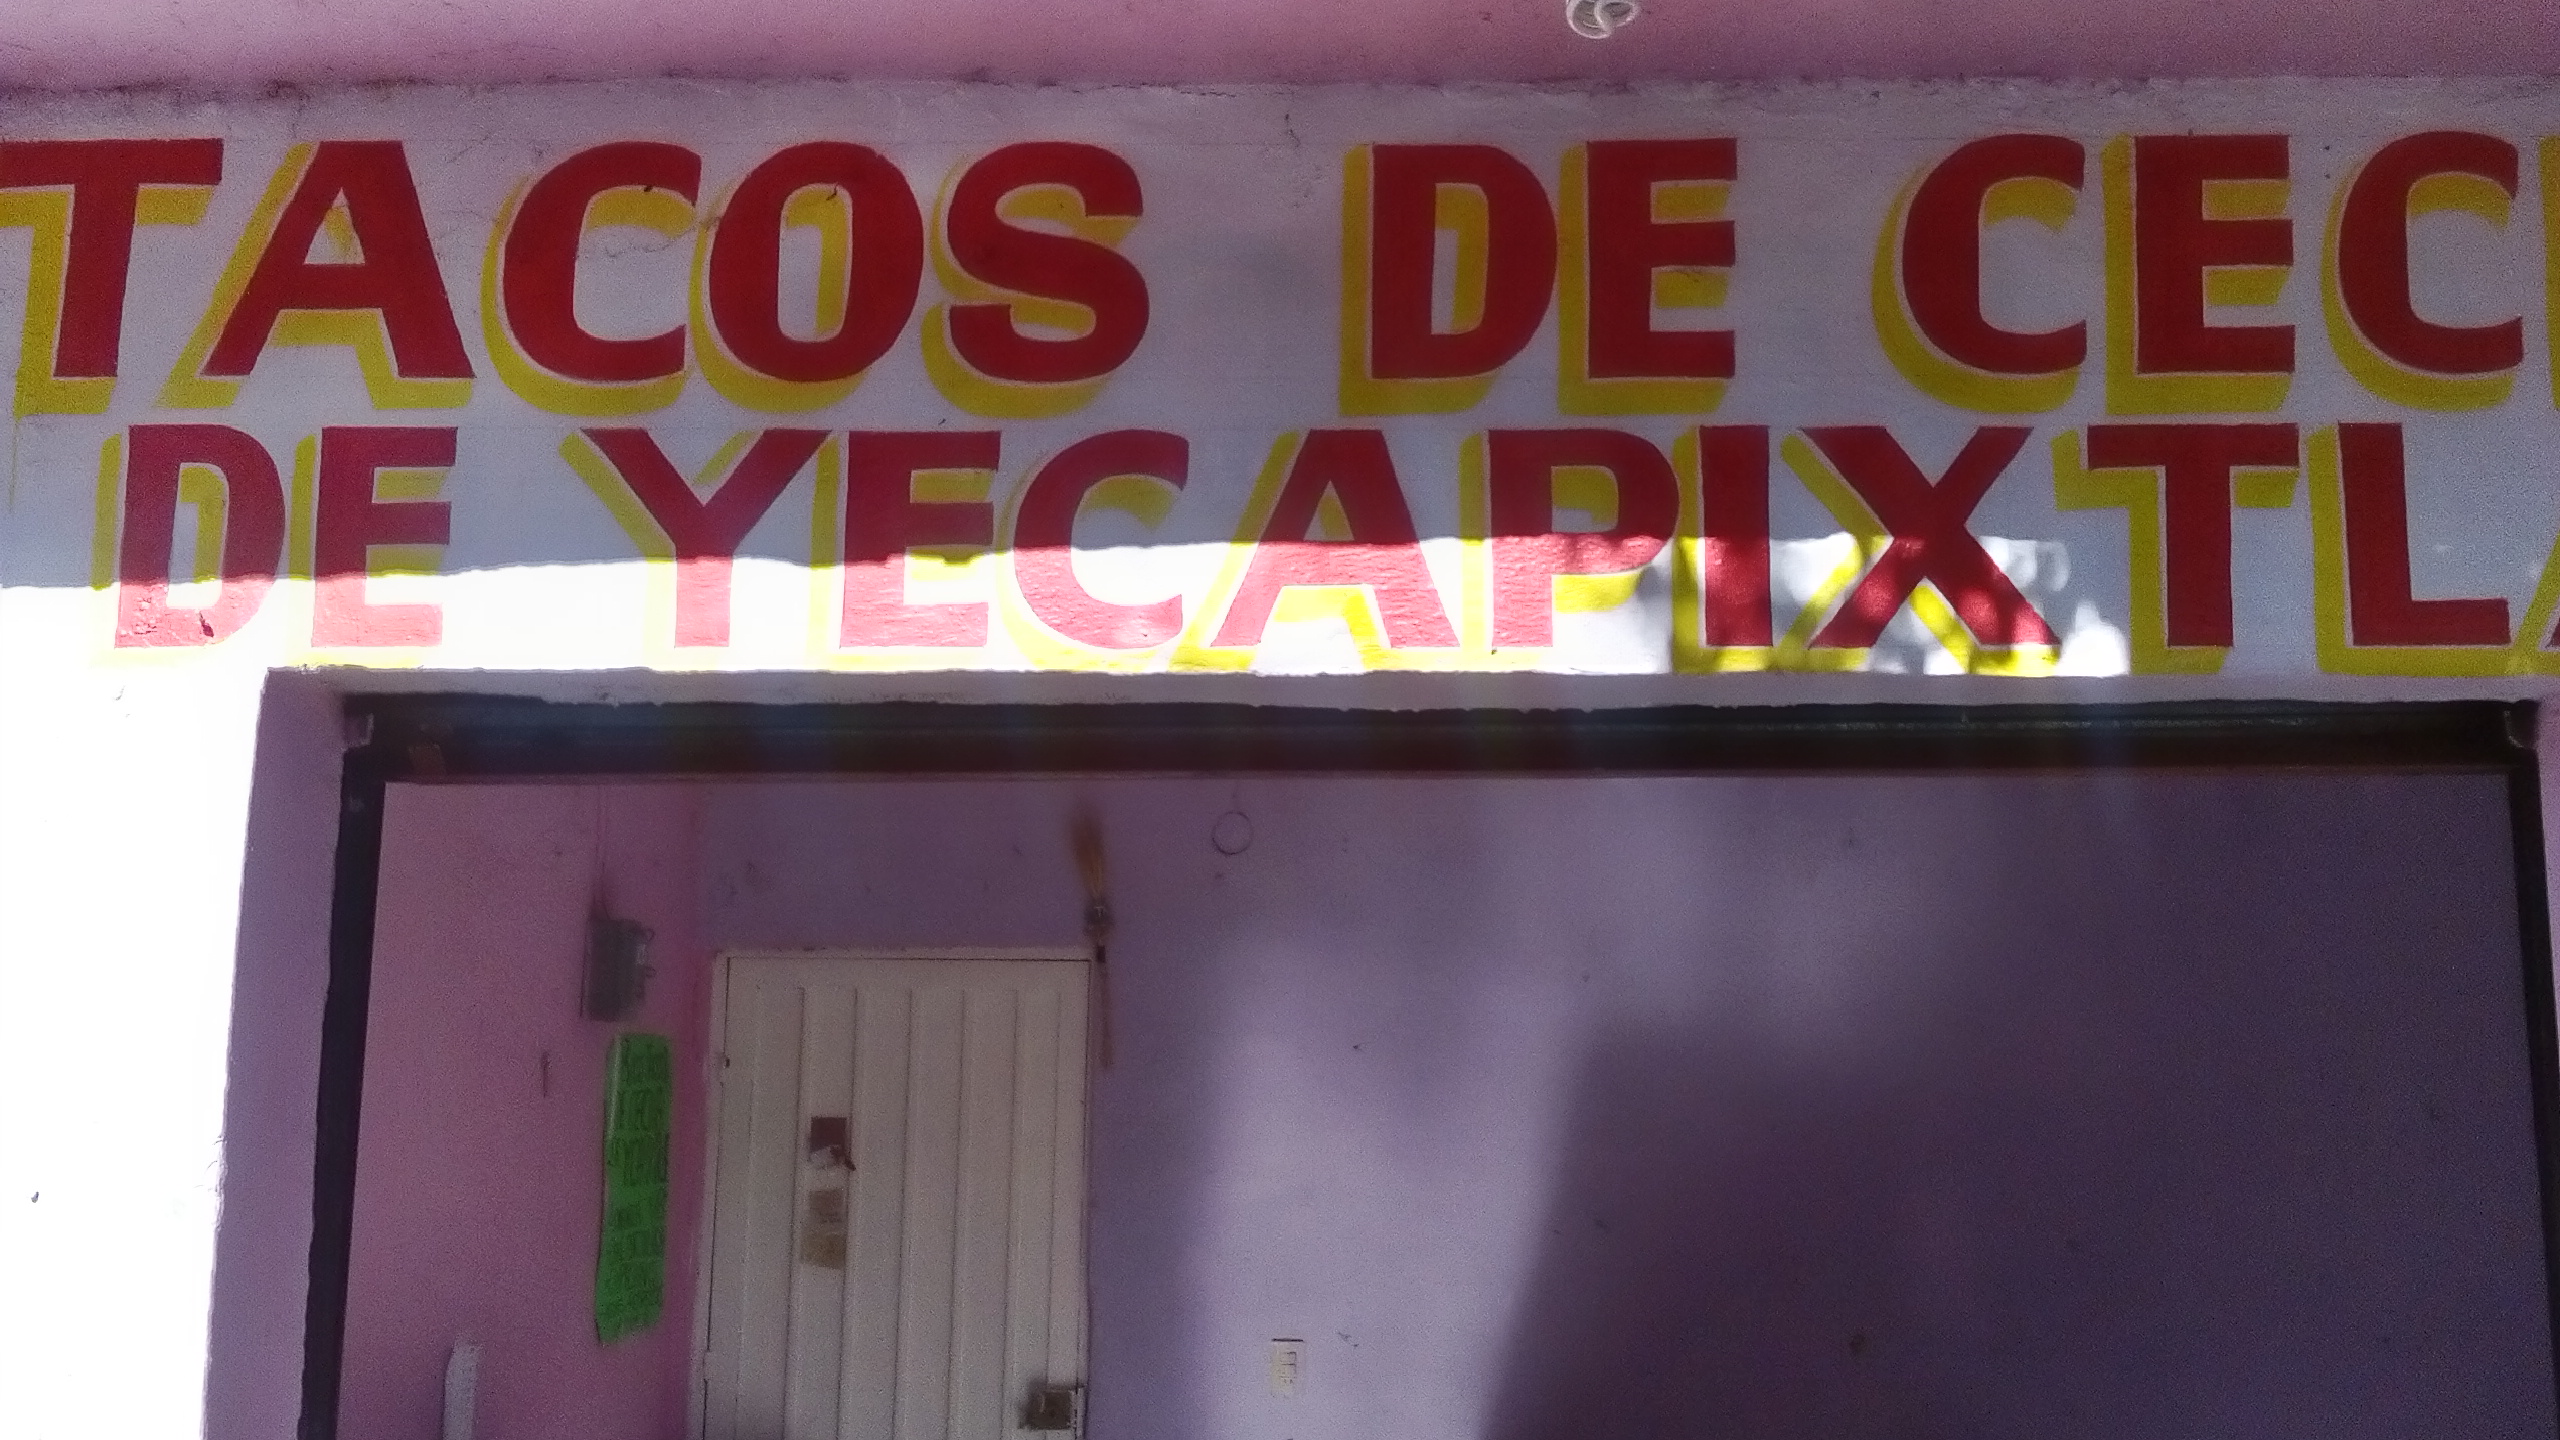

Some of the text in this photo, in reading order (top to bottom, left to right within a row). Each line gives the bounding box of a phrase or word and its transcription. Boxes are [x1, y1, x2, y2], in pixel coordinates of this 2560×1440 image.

[0, 131, 2560, 384] TACOS DE CEC
[114, 422, 2560, 651] DE YECAPIXTL
